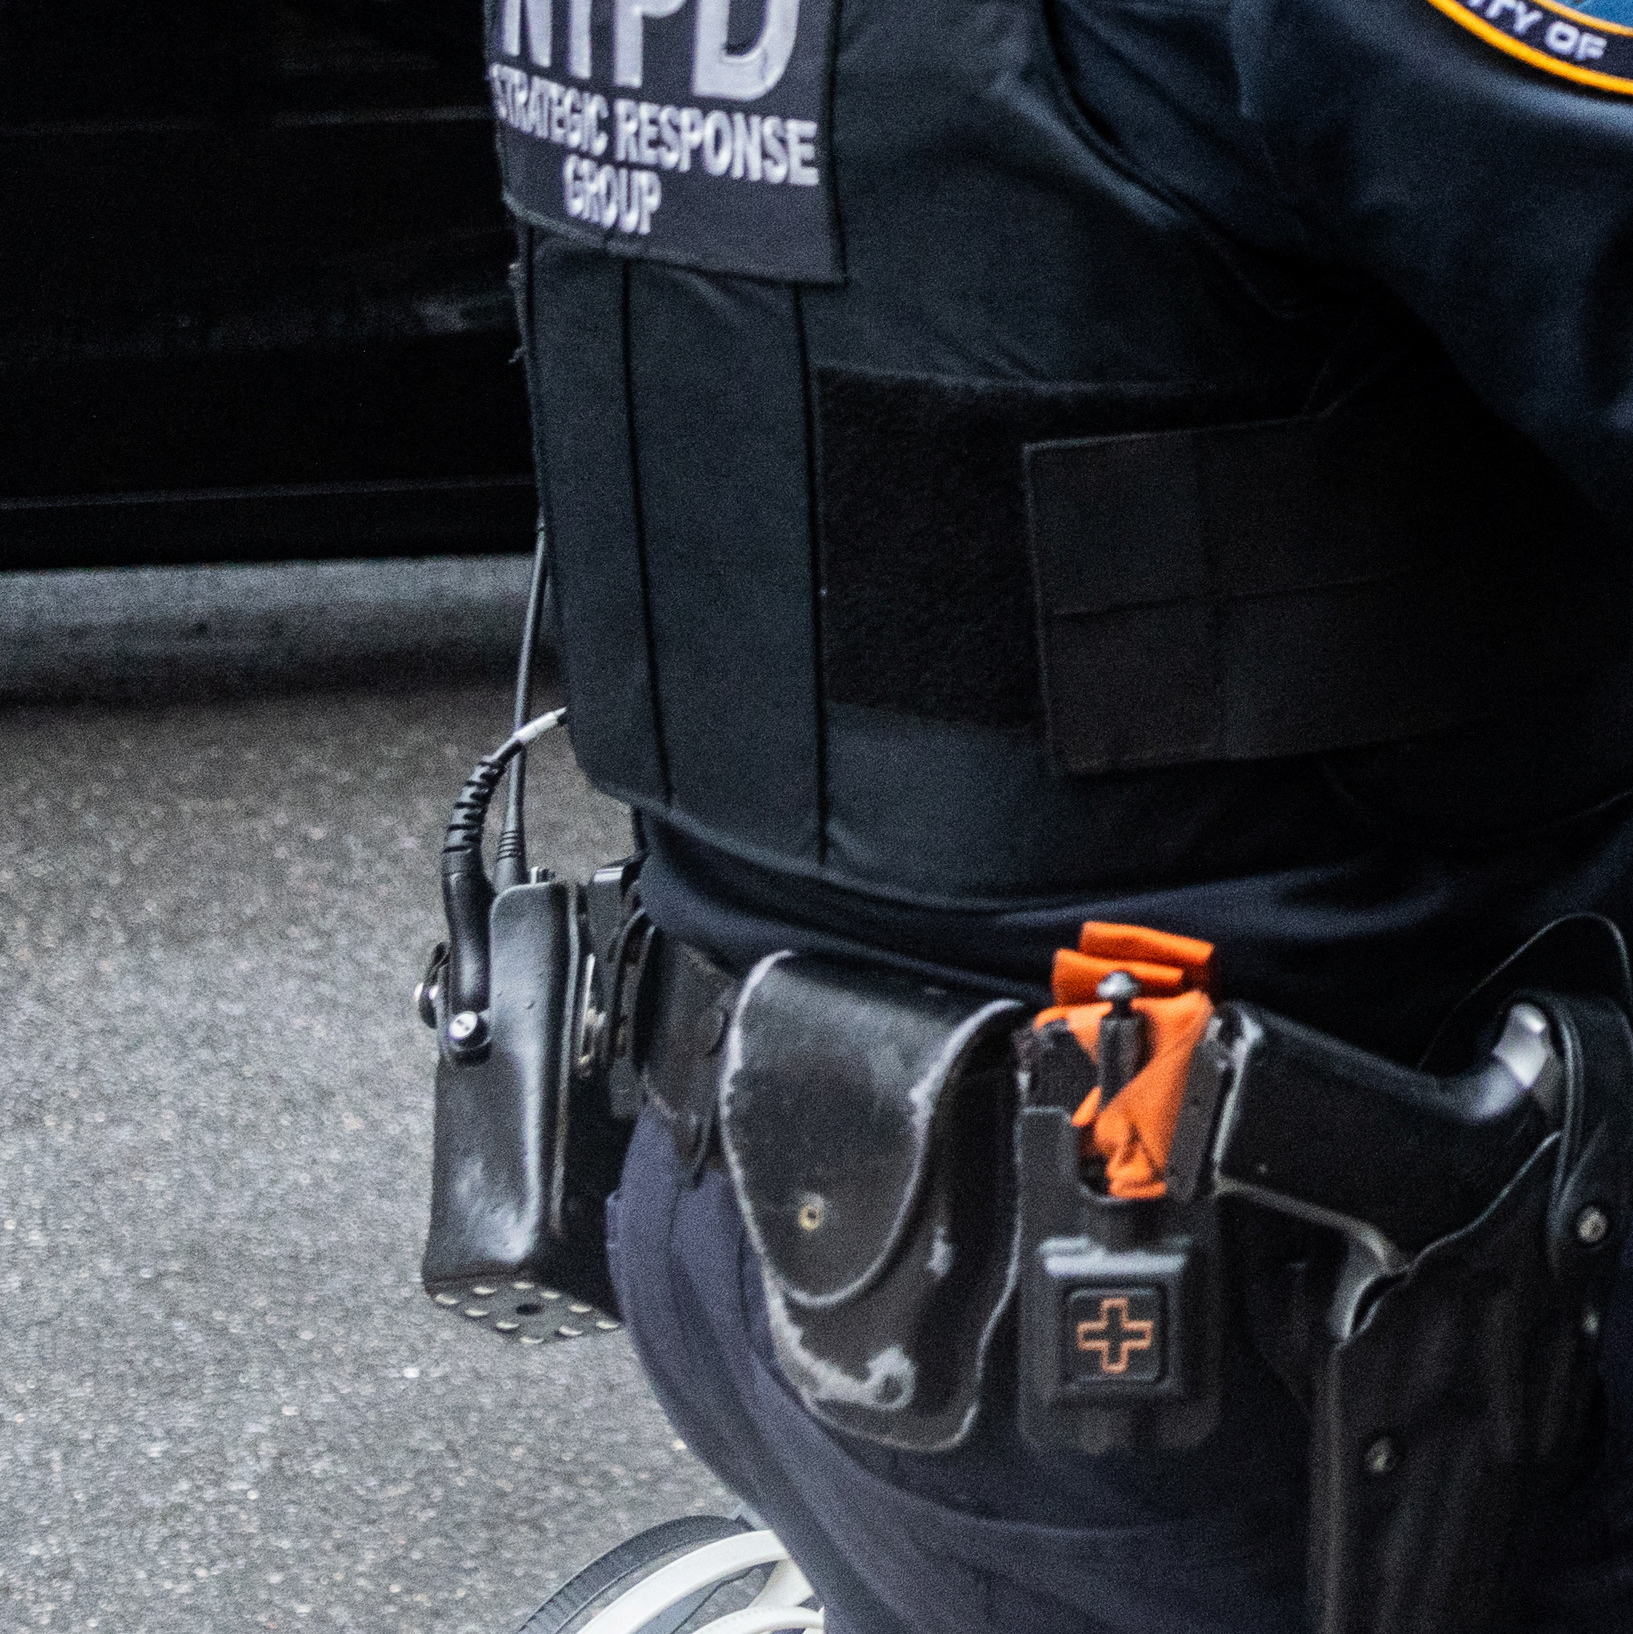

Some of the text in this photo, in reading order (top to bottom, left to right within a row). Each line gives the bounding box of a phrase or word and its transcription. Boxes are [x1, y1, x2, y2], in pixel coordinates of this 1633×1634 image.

[1545, 20, 1609, 62] OF
[613, 97, 820, 187] RESPONSE
[563, 153, 662, 235] GROUP
